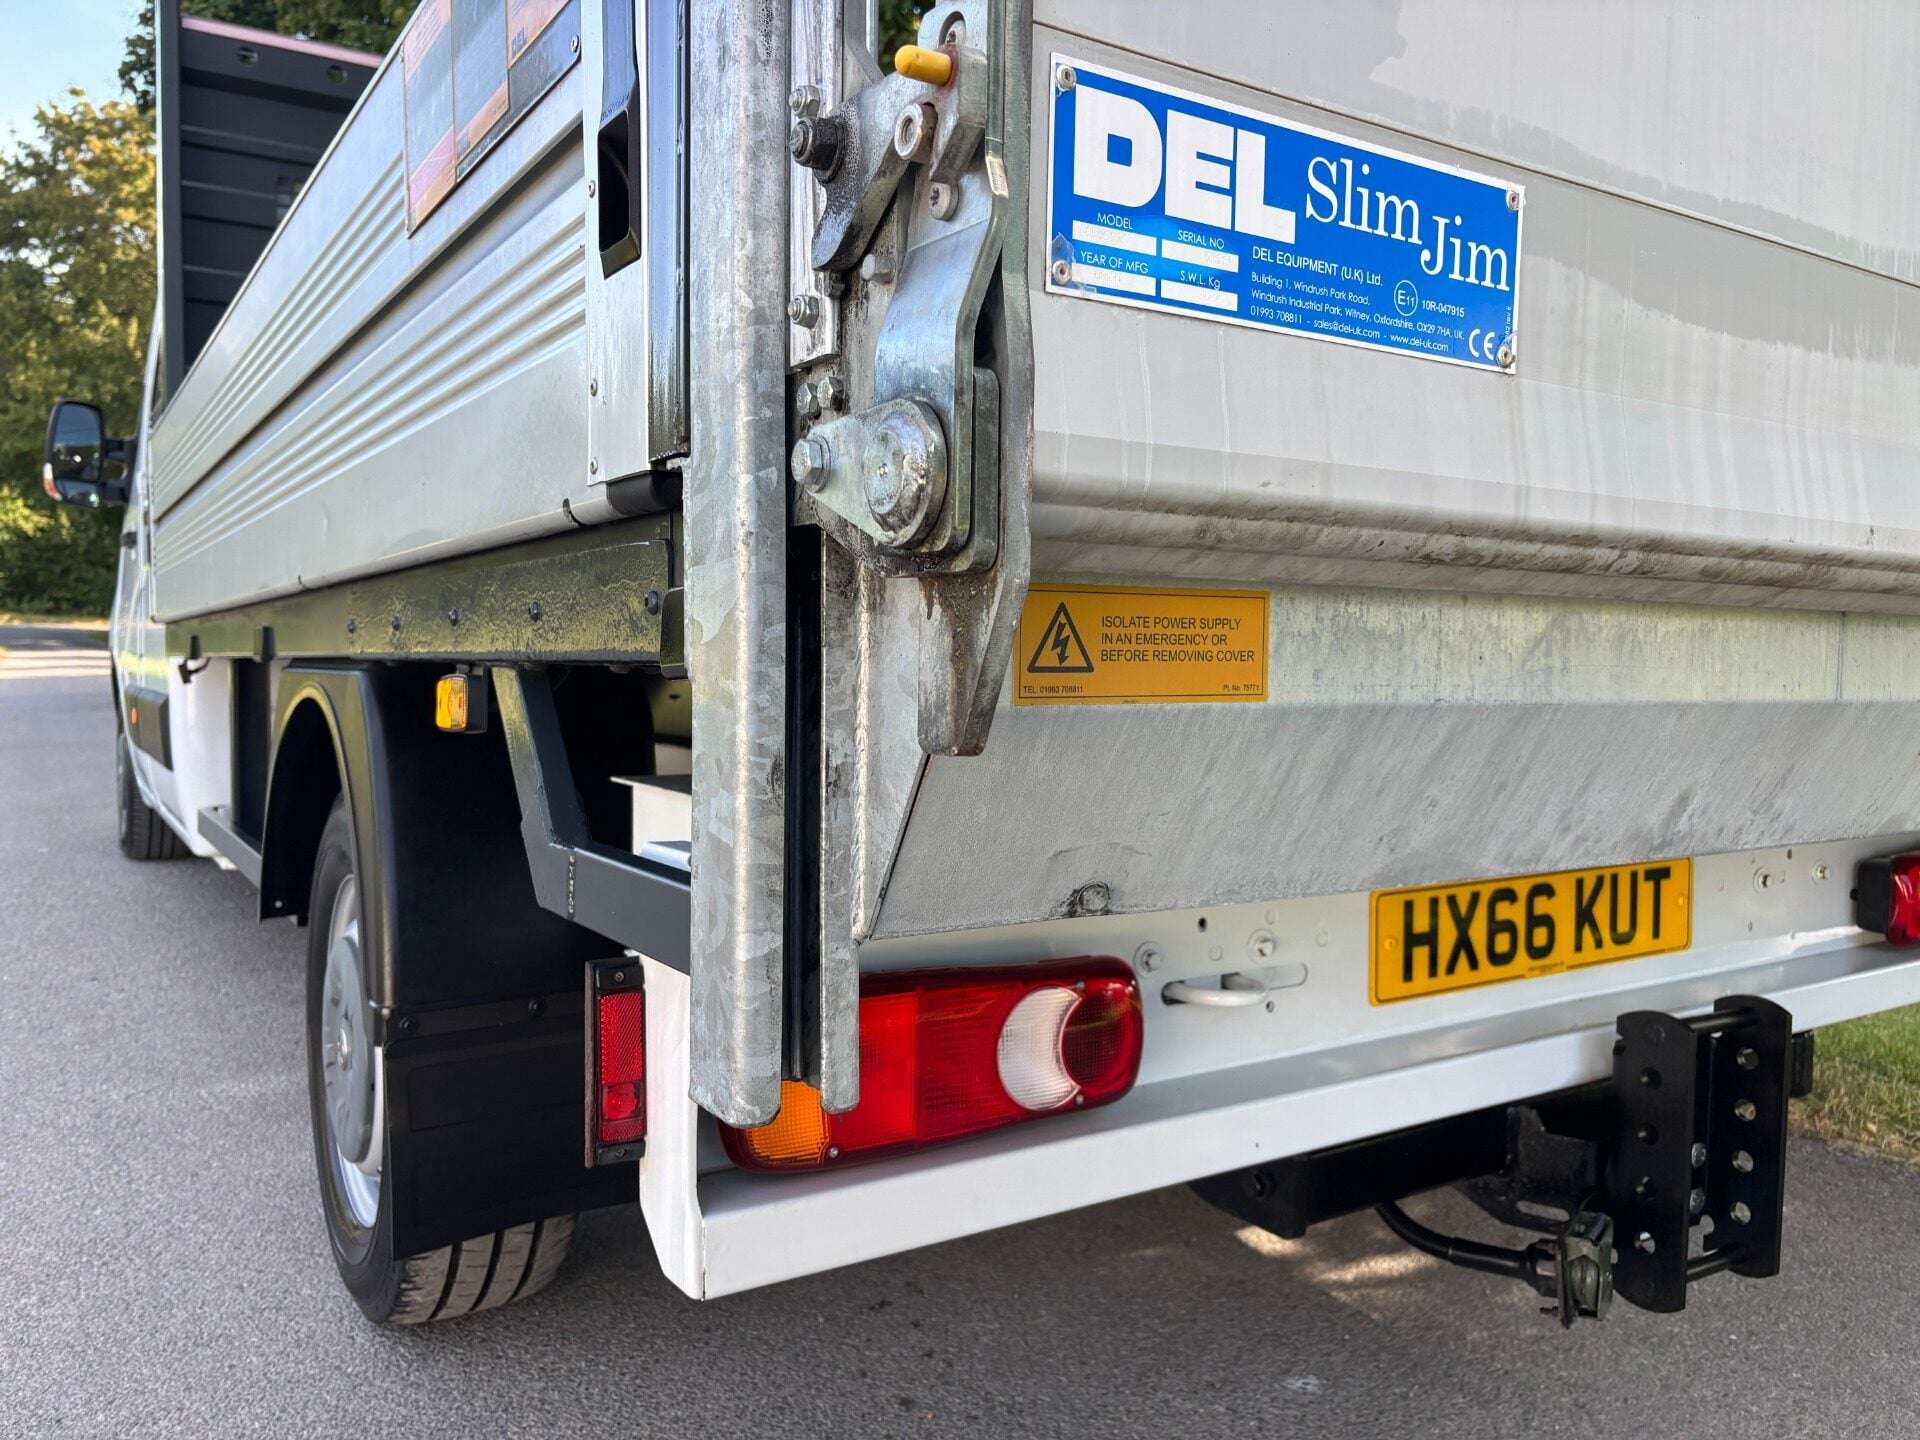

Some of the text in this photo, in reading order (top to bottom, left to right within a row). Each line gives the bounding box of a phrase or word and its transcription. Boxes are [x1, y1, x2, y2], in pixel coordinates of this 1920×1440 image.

[1073, 84, 1296, 244] DEL
[1305, 156, 1423, 246] Slim
[1097, 212, 1133, 230] MODEL
[1177, 229, 1224, 250] SERIAL NO
[1080, 250, 1149, 274] YEAR OF MFG
[1420, 215, 1510, 291] Jim
[1252, 246, 1274, 263] DEL
[1277, 251, 1339, 276] EQUIPMENT
[1341, 266, 1364, 284] (U.K)
[1366, 271, 1383, 287] Ltd.
[1180, 270, 1221, 291] S.W.L. Kg
[1251, 271, 1283, 289] Building
[1293, 280, 1329, 297] Windrush
[1330, 288, 1347, 300] Park
[1251, 288, 1288, 304] Windrush
[1289, 296, 1323, 311] Industrial
[1416, 322, 1436, 334] OX29
[1421, 299, 1465, 318] 10R-047915
[1250, 305, 1274, 319] 01993
[1276, 310, 1302, 324] 708811
[1313, 319, 1380, 339] sales@del-uk.com
[1390, 333, 1449, 352] www.del-uk.com
[1101, 615, 1242, 631] ISOLATE POWER SUPPLY
[1101, 633, 1228, 646] IN AN EMERGENCY OR
[1100, 649, 1255, 663] BEFORE REMOVING COVER
[1402, 866, 1671, 983] HX66 KUT
